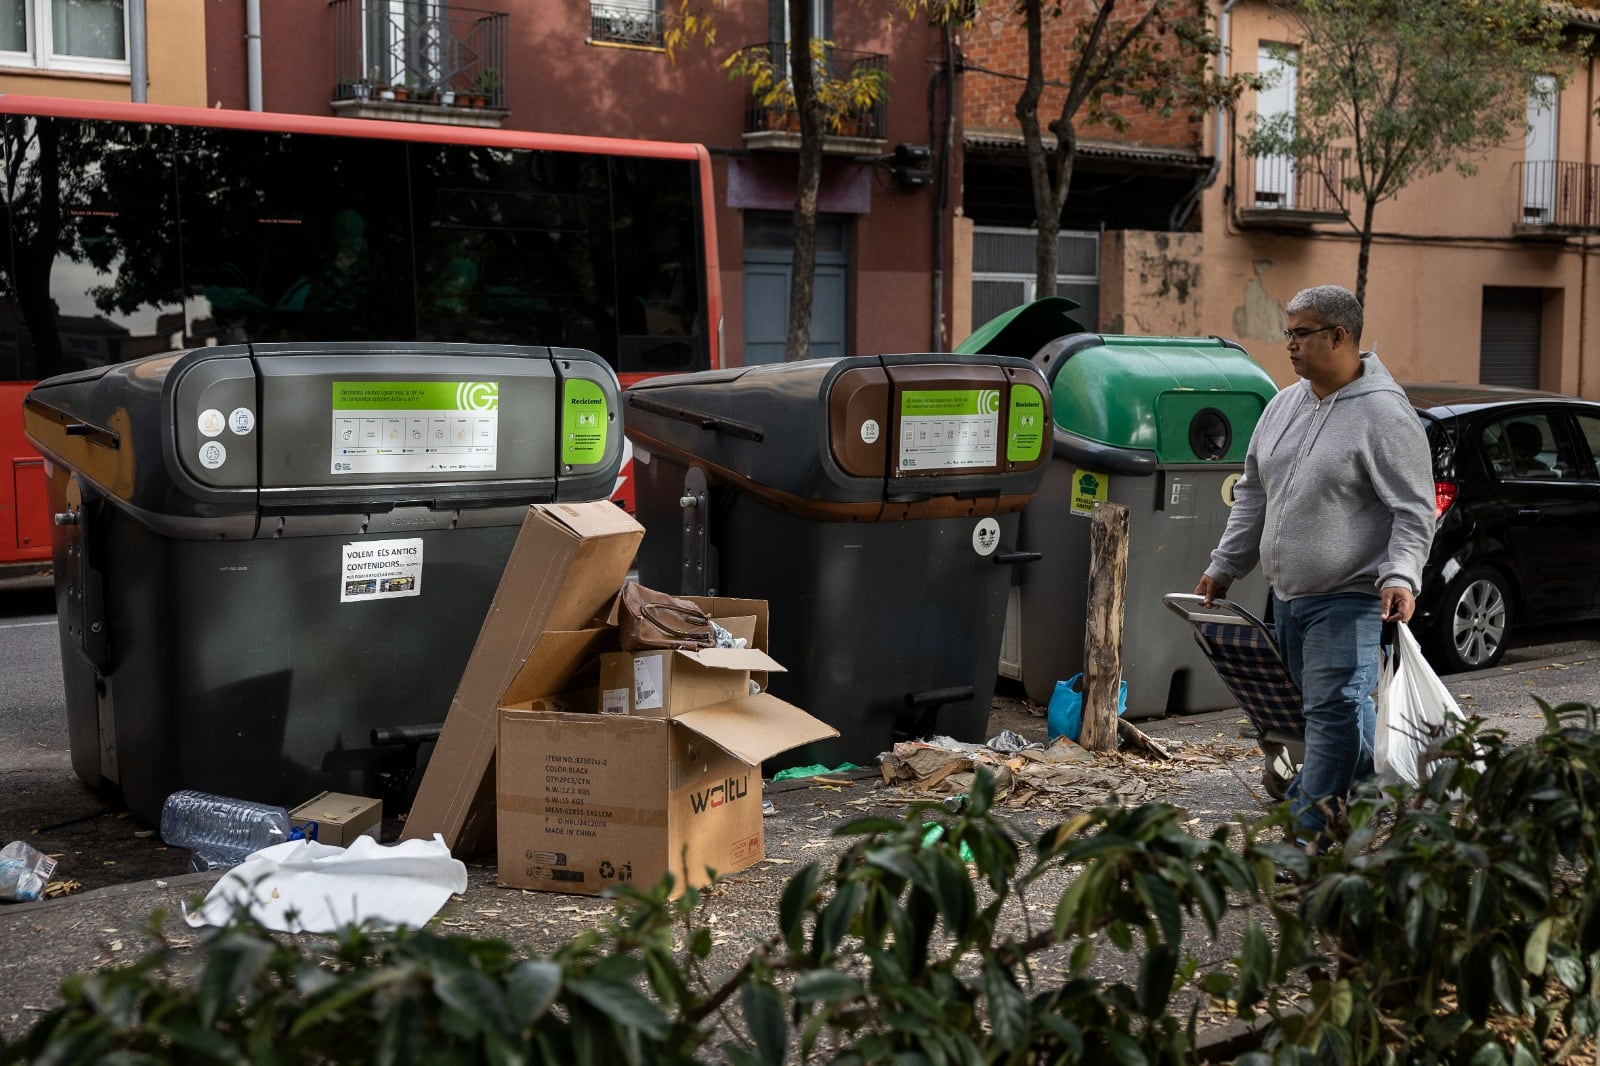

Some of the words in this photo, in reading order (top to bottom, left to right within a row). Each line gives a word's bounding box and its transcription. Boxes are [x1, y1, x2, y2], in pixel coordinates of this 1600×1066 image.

[347, 550, 374, 559] VOLEM
[378, 548, 390, 557] ELS
[391, 547, 417, 556] ANTICS
[346, 560, 400, 571] CONTENIDORS
[545, 754, 561, 762] ITEM
[545, 826, 564, 835] MADE
[566, 828, 574, 836] IN
[576, 829, 597, 837] CHINA
